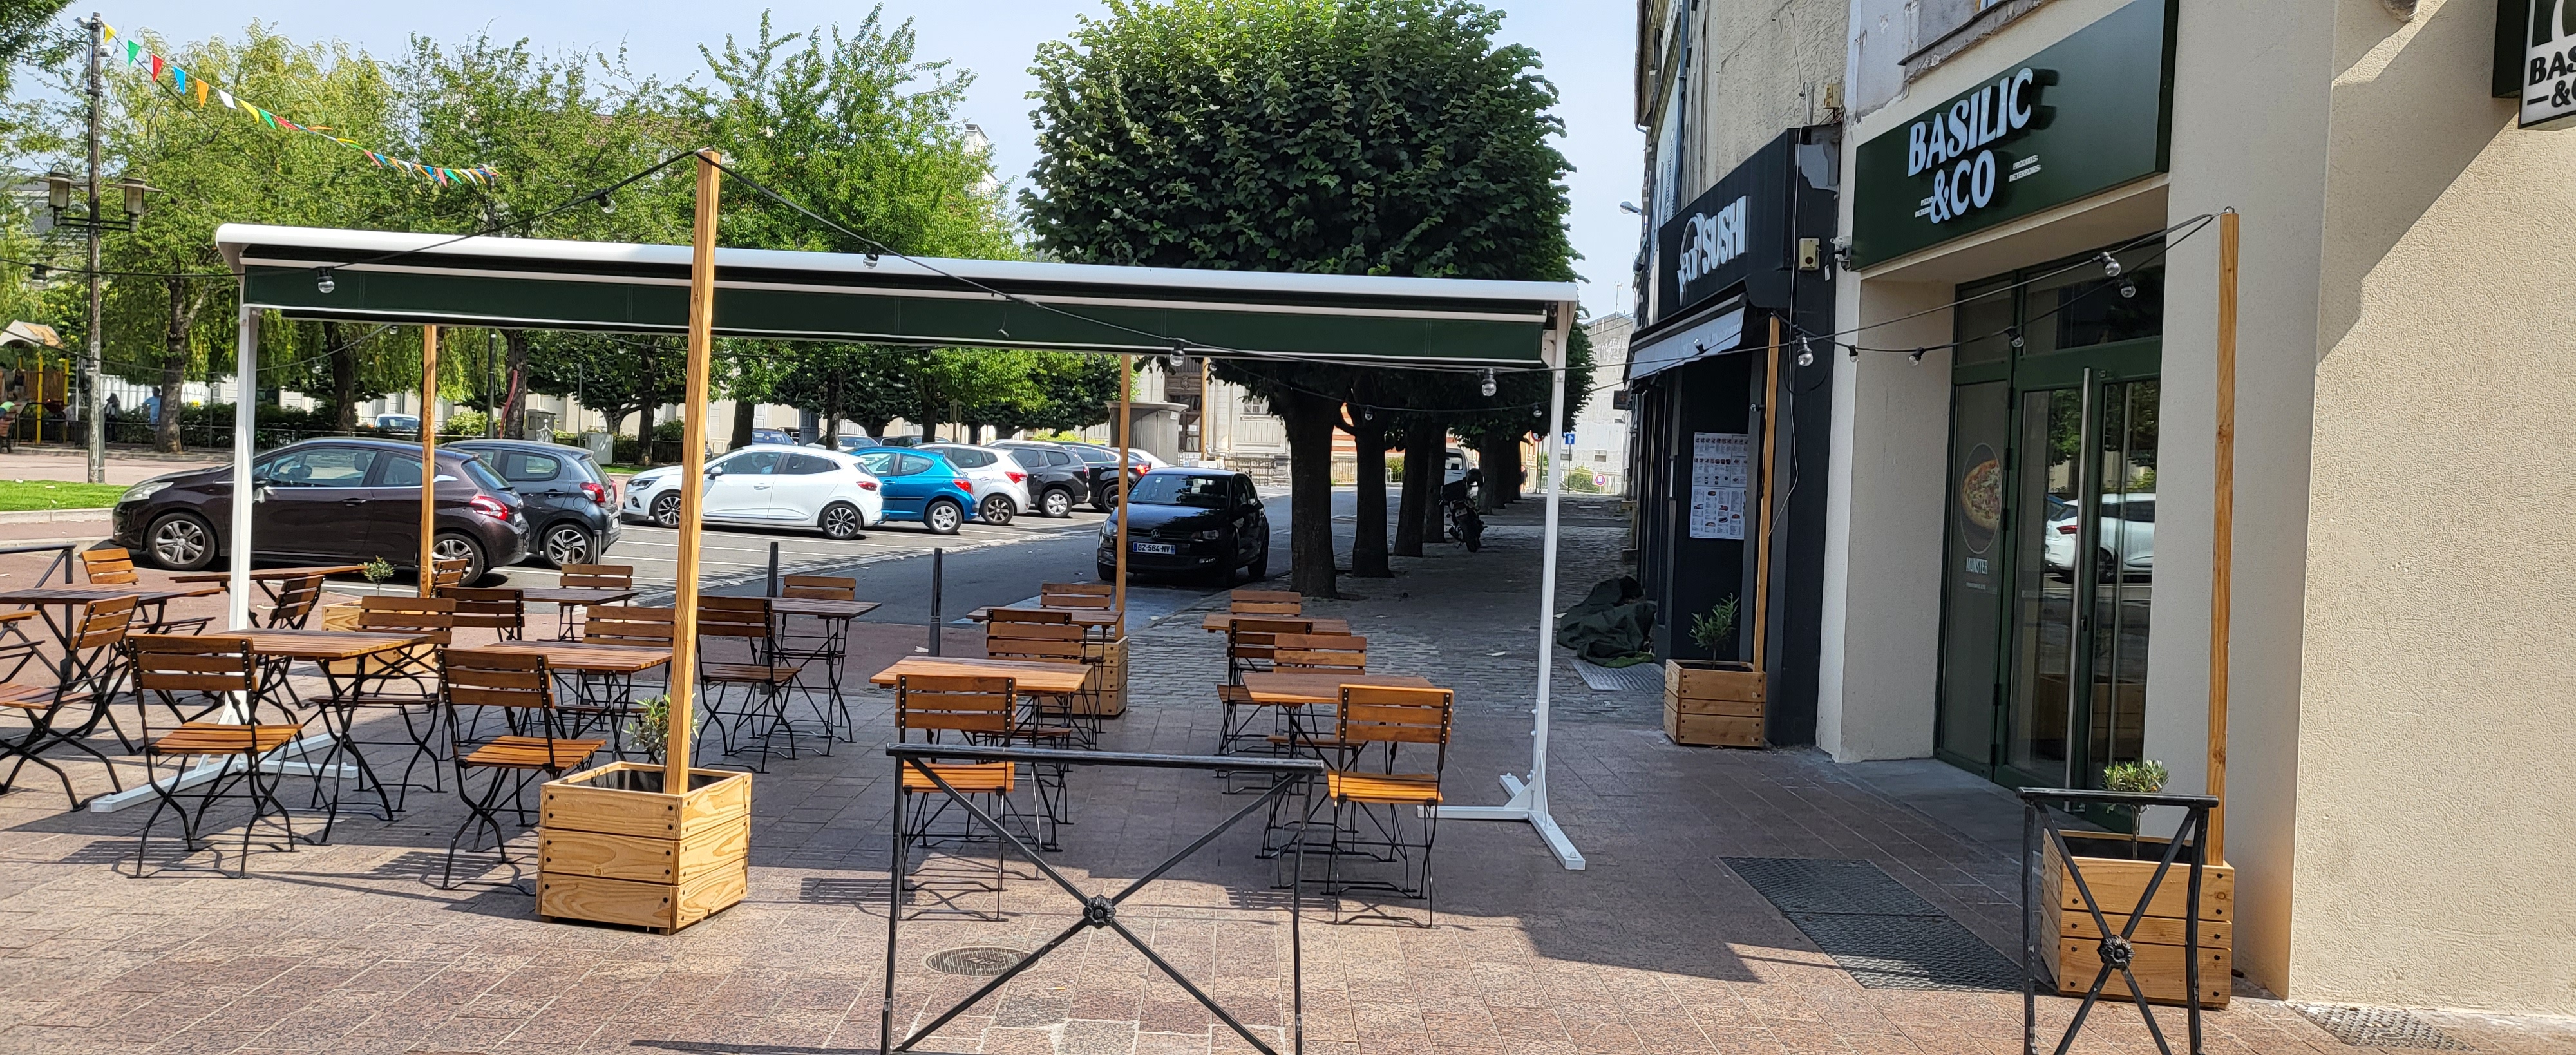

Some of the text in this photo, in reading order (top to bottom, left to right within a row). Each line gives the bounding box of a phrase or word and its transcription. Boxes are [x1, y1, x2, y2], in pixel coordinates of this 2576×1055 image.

[1908, 68, 2033, 177] BASILIC
[1930, 149, 1995, 223] &CO
[1702, 195, 1747, 274] SUSHI
